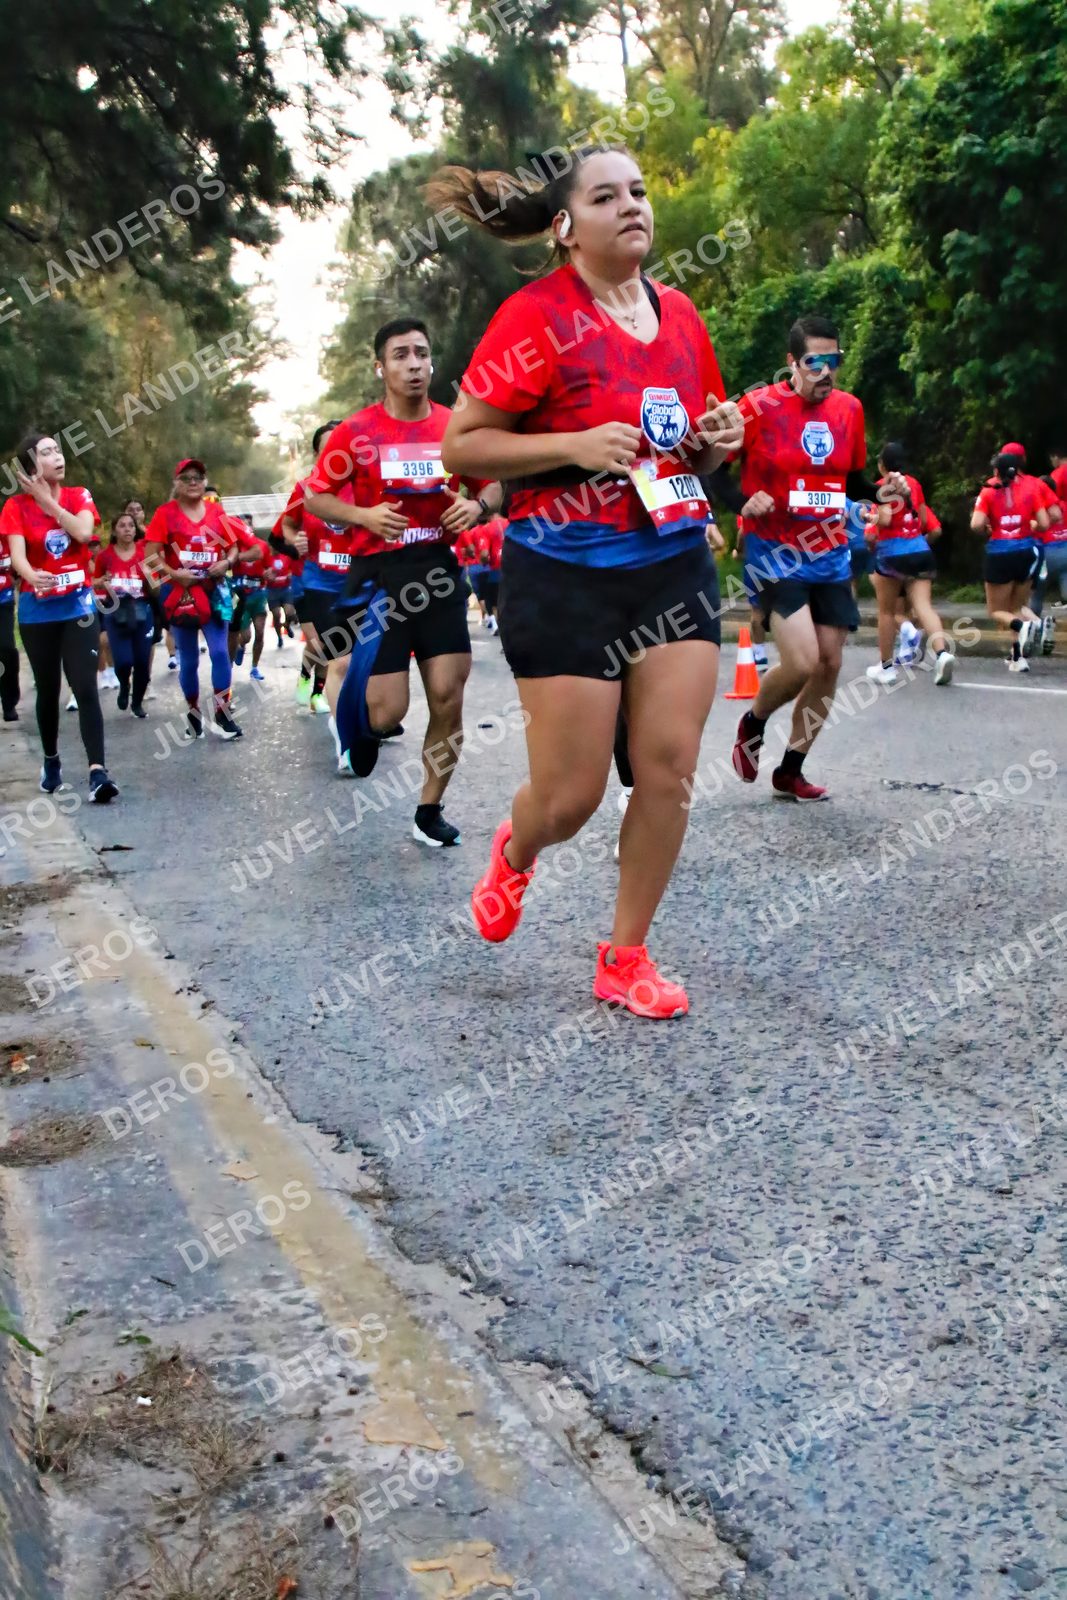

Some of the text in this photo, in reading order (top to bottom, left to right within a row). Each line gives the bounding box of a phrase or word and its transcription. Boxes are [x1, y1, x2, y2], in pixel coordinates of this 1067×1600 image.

[648, 413, 668, 425] Race
[402, 462, 434, 476] 3396
[807, 492, 832, 506] 3307
